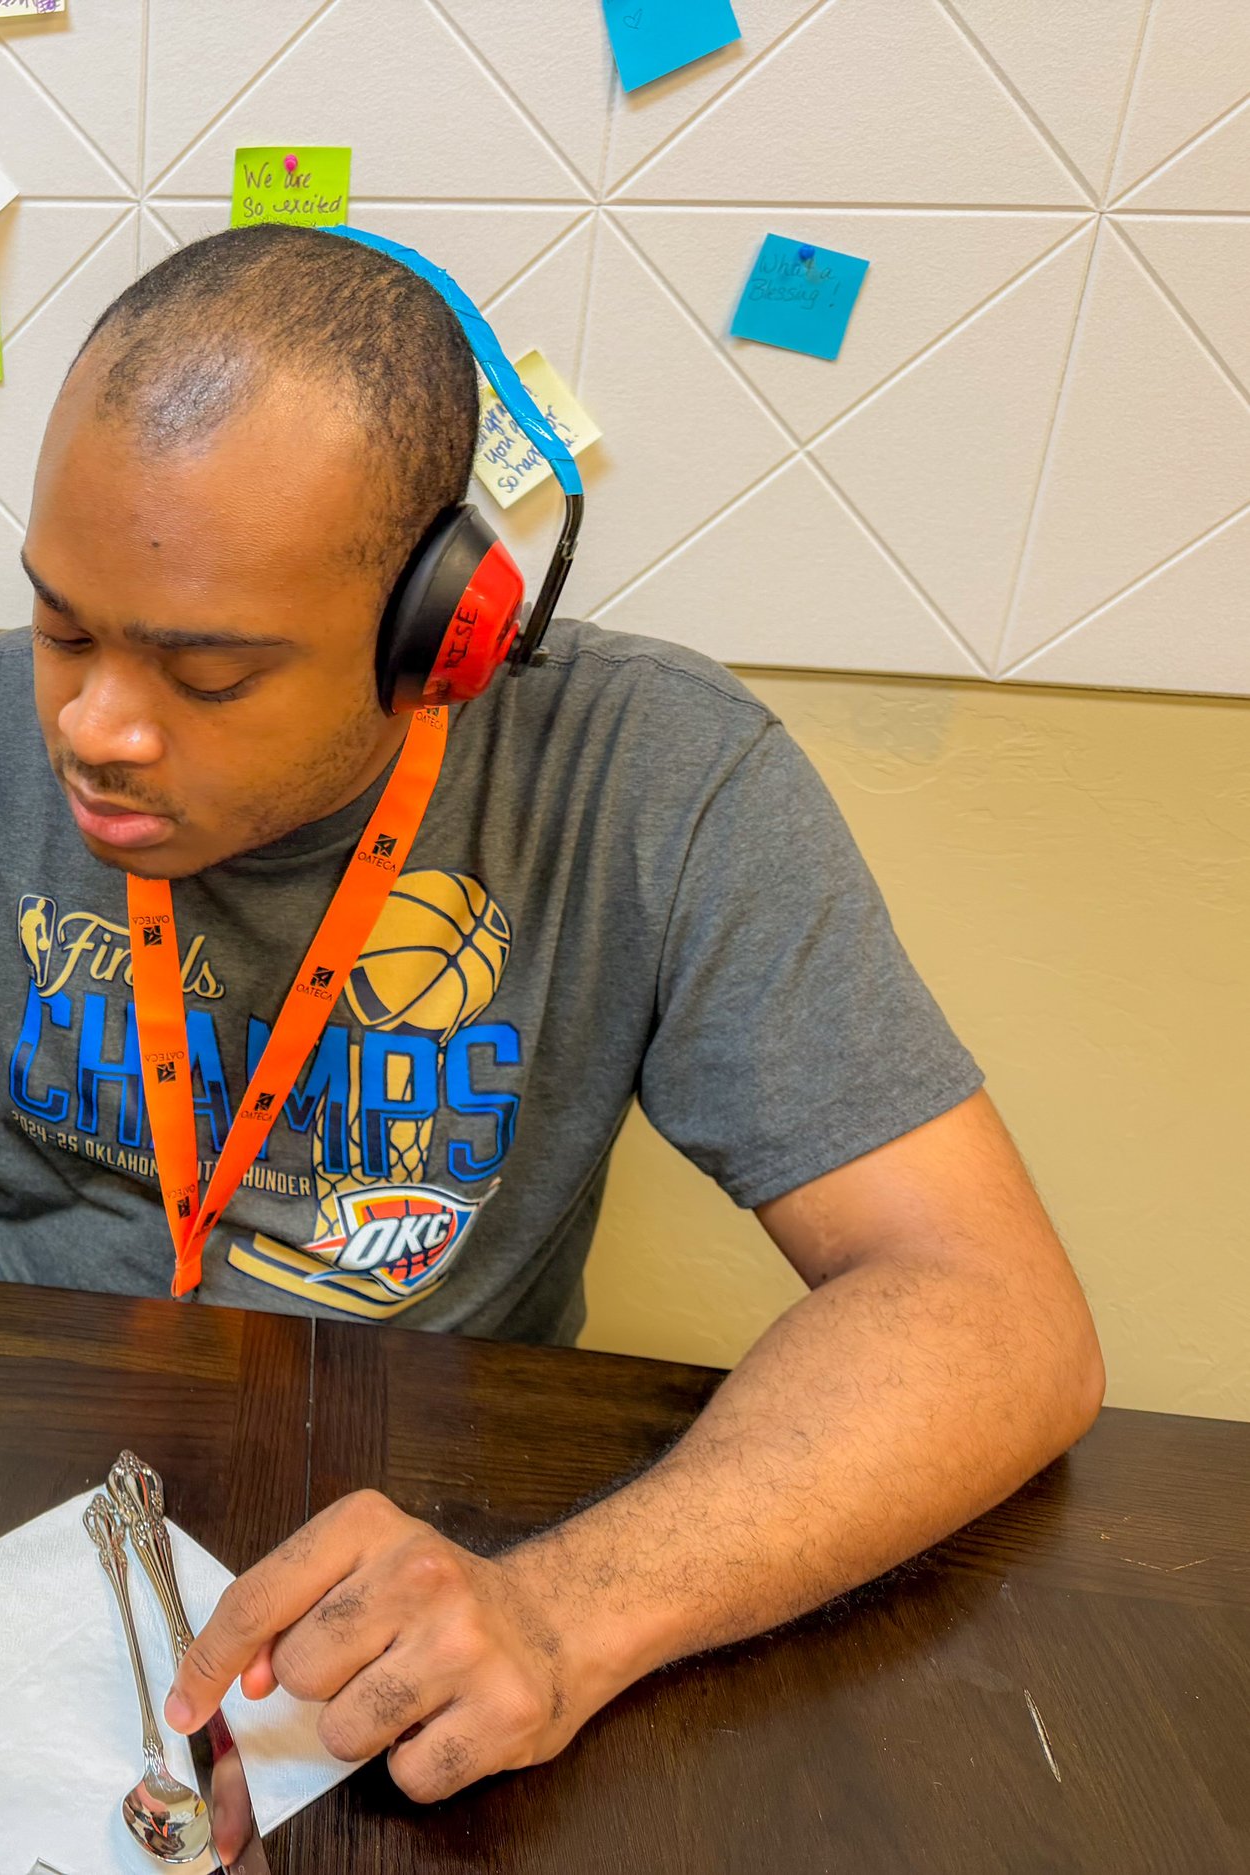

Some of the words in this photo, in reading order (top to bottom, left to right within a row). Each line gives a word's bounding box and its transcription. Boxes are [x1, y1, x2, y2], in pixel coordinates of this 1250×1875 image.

[243, 161, 273, 189] We
[283, 170, 312, 190] are
[272, 193, 343, 215] excited
[415, 711, 444, 732] OATECA
[357, 850, 397, 873] OATECA
[132, 914, 171, 925] OATECA
[37, 911, 225, 999] Finls
[296, 983, 333, 1001] OATECA
[145, 1050, 185, 1062] OATECA
[8, 979, 522, 1183] CHAMPS
[240, 1110, 273, 1122] OATECA
[241, 1165, 312, 1196] HUNDER
[337, 1213, 452, 1271] OKC
